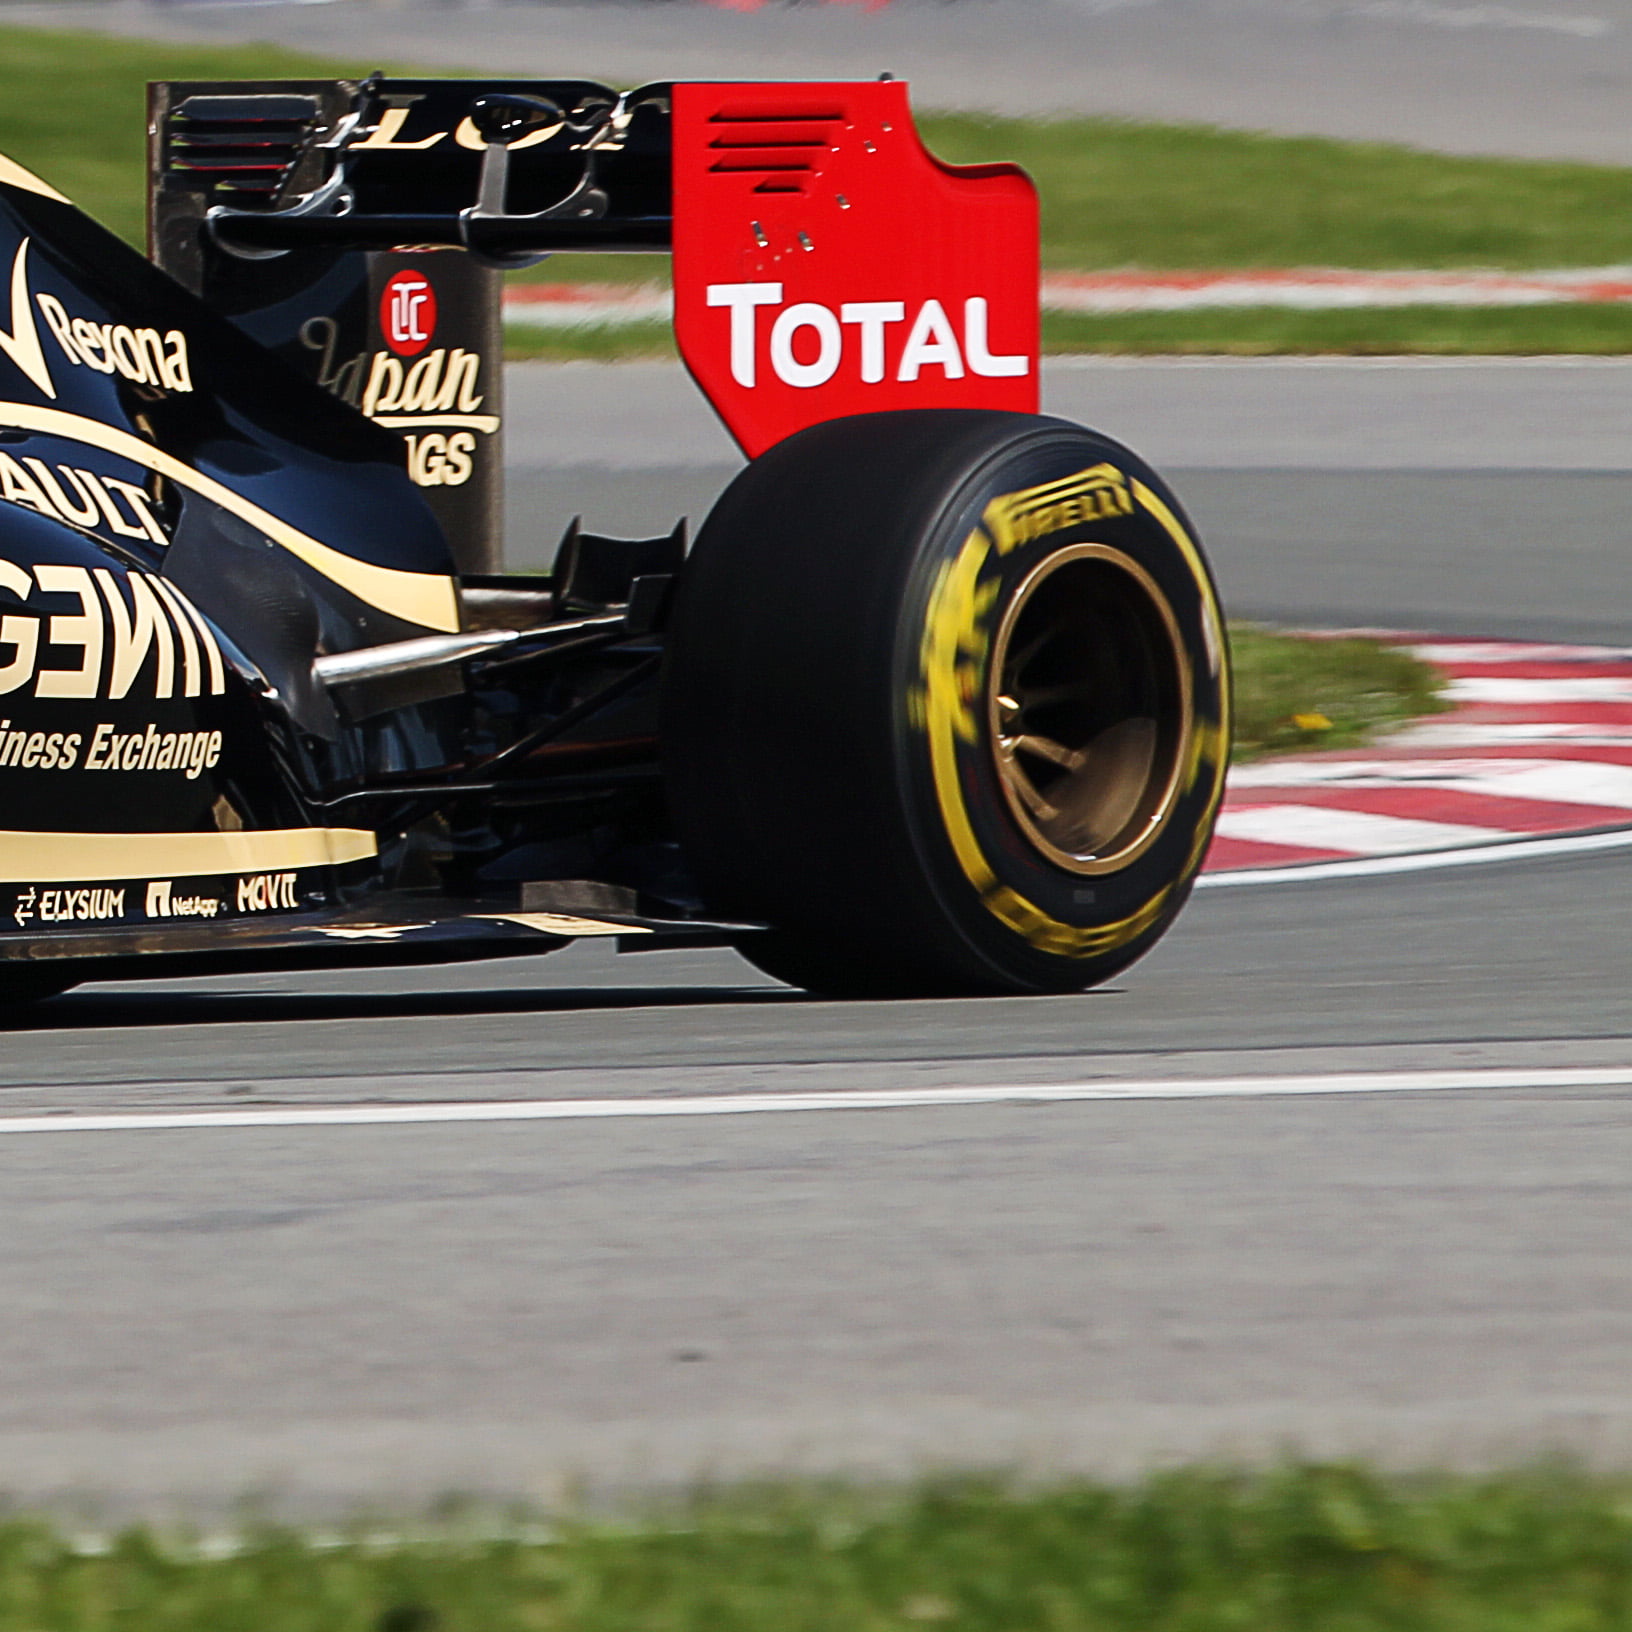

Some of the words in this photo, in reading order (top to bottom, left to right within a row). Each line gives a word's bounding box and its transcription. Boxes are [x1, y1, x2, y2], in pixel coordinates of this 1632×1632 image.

[35, 292, 194, 393] Rexona
[981, 461, 1135, 557] PIRELLI
[83, 723, 223, 780] Exchange
[39, 888, 126, 922] ELYSIUM
[171, 895, 220, 918] NetApp
